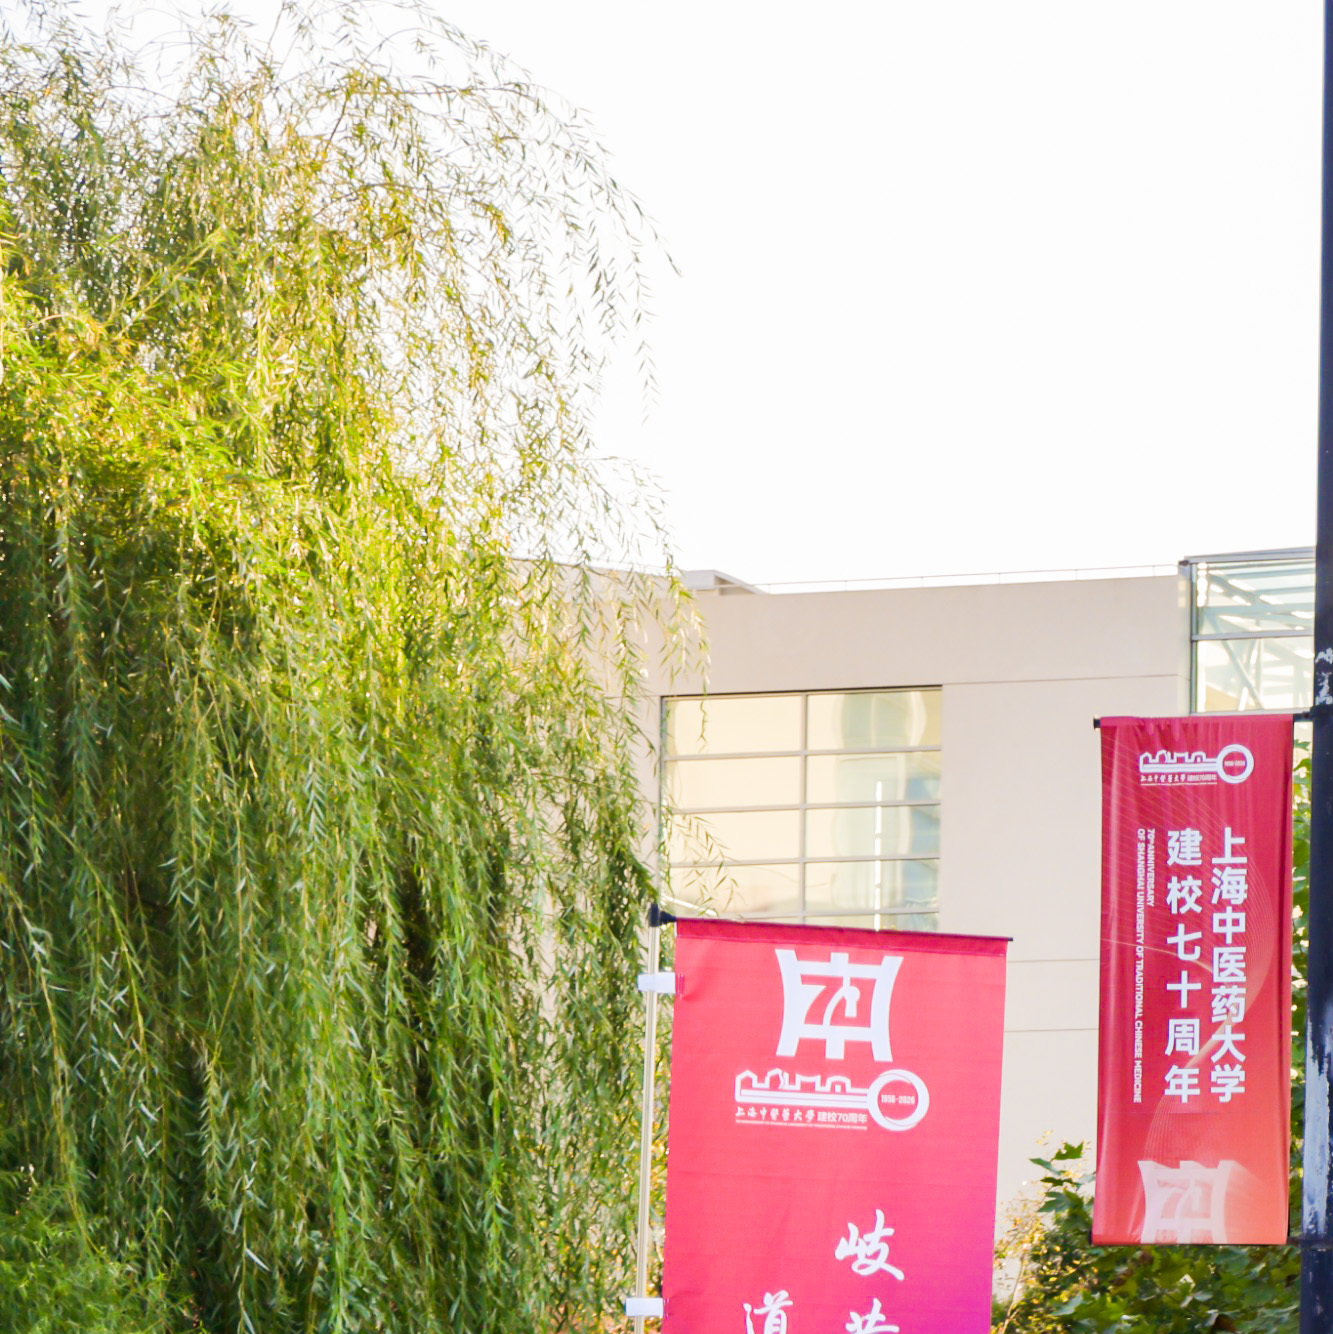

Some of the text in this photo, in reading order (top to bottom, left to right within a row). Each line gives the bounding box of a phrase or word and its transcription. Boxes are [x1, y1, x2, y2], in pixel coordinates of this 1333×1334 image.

[1133, 828, 1146, 1103] OF SHANGHAI UNIVERSITY OF TRADITIONAL CHINESE MEDICINE
[1146, 841, 1155, 907] ANNIVERSARY
[1164, 827, 1203, 1104] 建校七十周年
[1210, 826, 1248, 1103] 上海中医药大学
